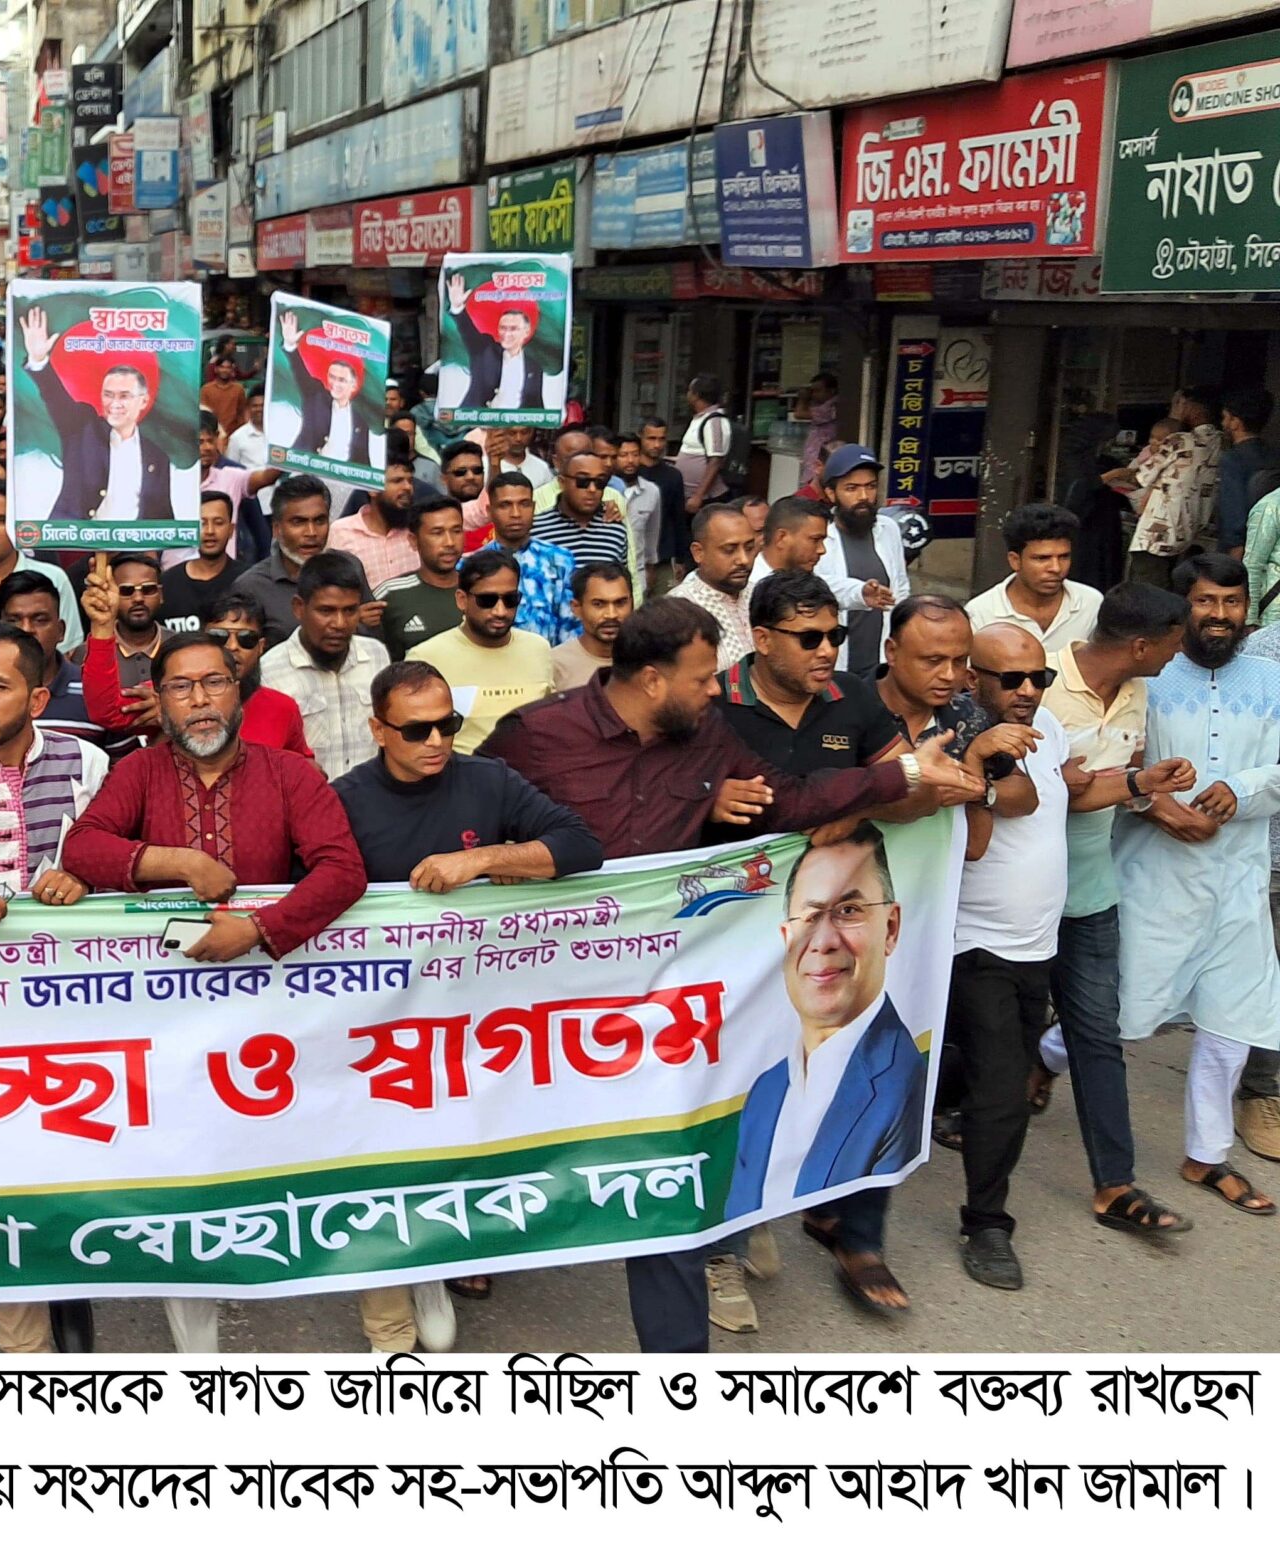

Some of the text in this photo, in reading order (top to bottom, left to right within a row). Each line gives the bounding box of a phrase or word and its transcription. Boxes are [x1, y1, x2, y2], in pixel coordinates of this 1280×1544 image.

[1195, 88, 1252, 111] MEDICINE
[1197, 77, 1229, 92] MODEL
[958, 99, 1081, 193] ফার্মেসী
[1119, 128, 1160, 159] মেসার্স
[1144, 147, 1264, 220] নাযাত
[410, 196, 462, 250] ফার্মেসী
[493, 273, 545, 288] স্বাগতম
[91, 310, 167, 332] স্বাগতম
[323, 321, 370, 345] স্বাগতম
[42, 524, 198, 543] সিলেট জেলা স্বেচ্ছাসেবক দল
[822, 734, 849, 744] GUCCI
[383, 911, 487, 949] মাননীয়
[498, 896, 623, 941] প্রধানমন্ত্রী
[21, 971, 133, 1007] জনাব
[144, 965, 272, 1002] তারেক
[283, 959, 412, 999] রহমান
[421, 956, 465, 980] এর
[476, 937, 560, 975] সিলেট
[571, 930, 682, 961] শুভাগমন
[207, 1034, 296, 1118] ও
[347, 981, 726, 1110] স্বাগতম
[70, 1172, 554, 1267] স্বেচ্ছাসেবক
[572, 1152, 710, 1219] দল
